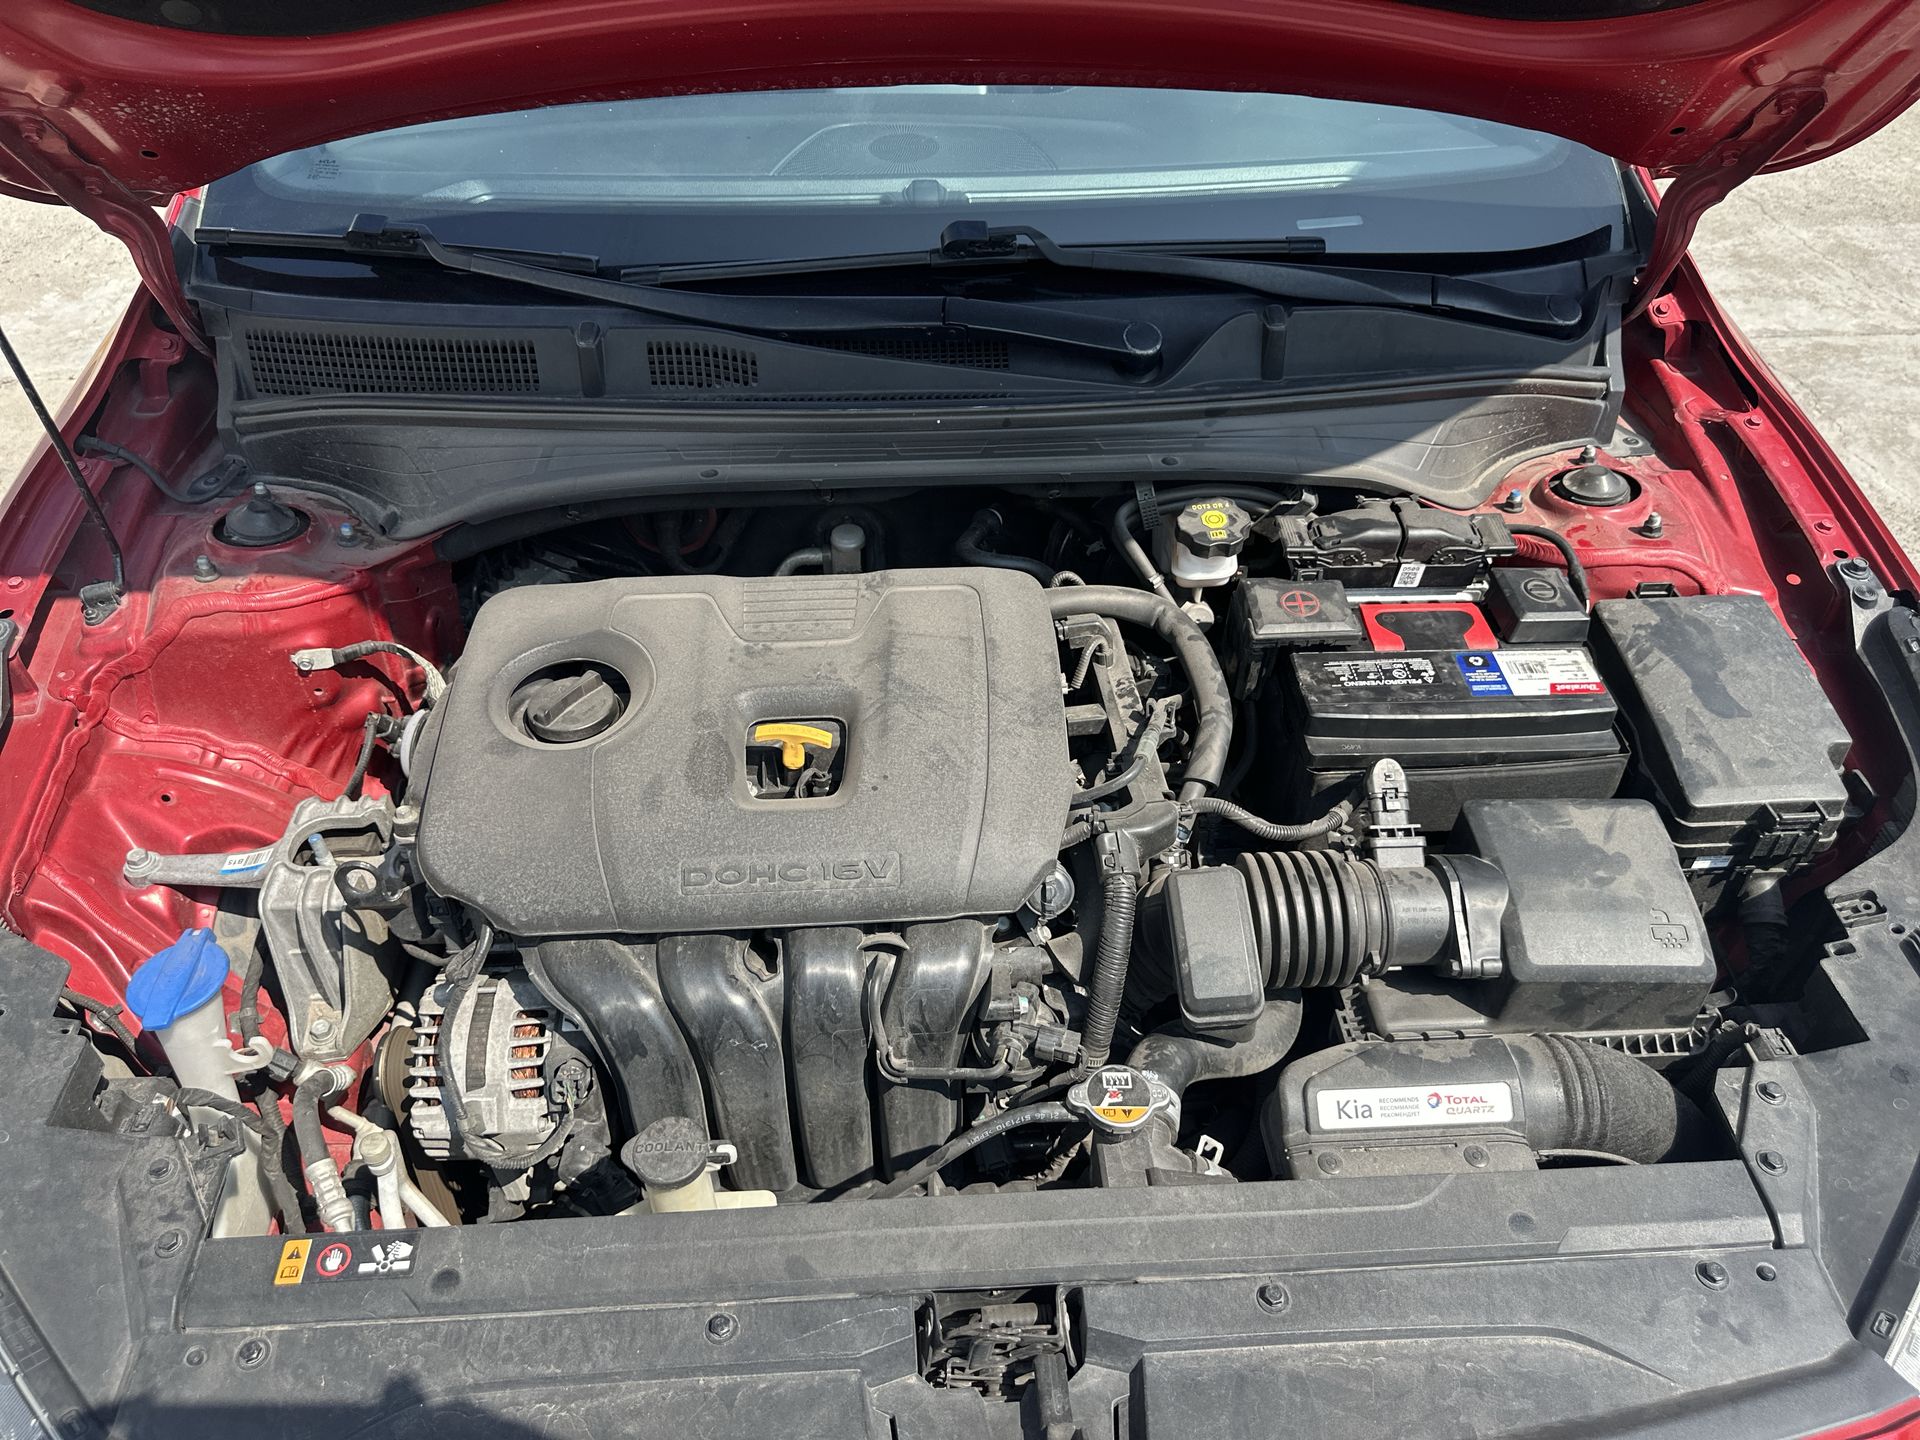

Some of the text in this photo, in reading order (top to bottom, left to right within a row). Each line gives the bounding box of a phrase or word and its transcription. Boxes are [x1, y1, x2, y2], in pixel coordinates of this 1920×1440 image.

[1191, 503, 1211, 511] DOT3
[1555, 683, 1599, 691] Duralast
[682, 858, 894, 887] DOHC 16V
[1378, 1096, 1419, 1104] RECOMMENDS
[1444, 1095, 1488, 1105] TOTAL
[1336, 1098, 1373, 1120] Kia
[1446, 1105, 1495, 1115] QUARTZ
[635, 1141, 706, 1154] COOLANT
